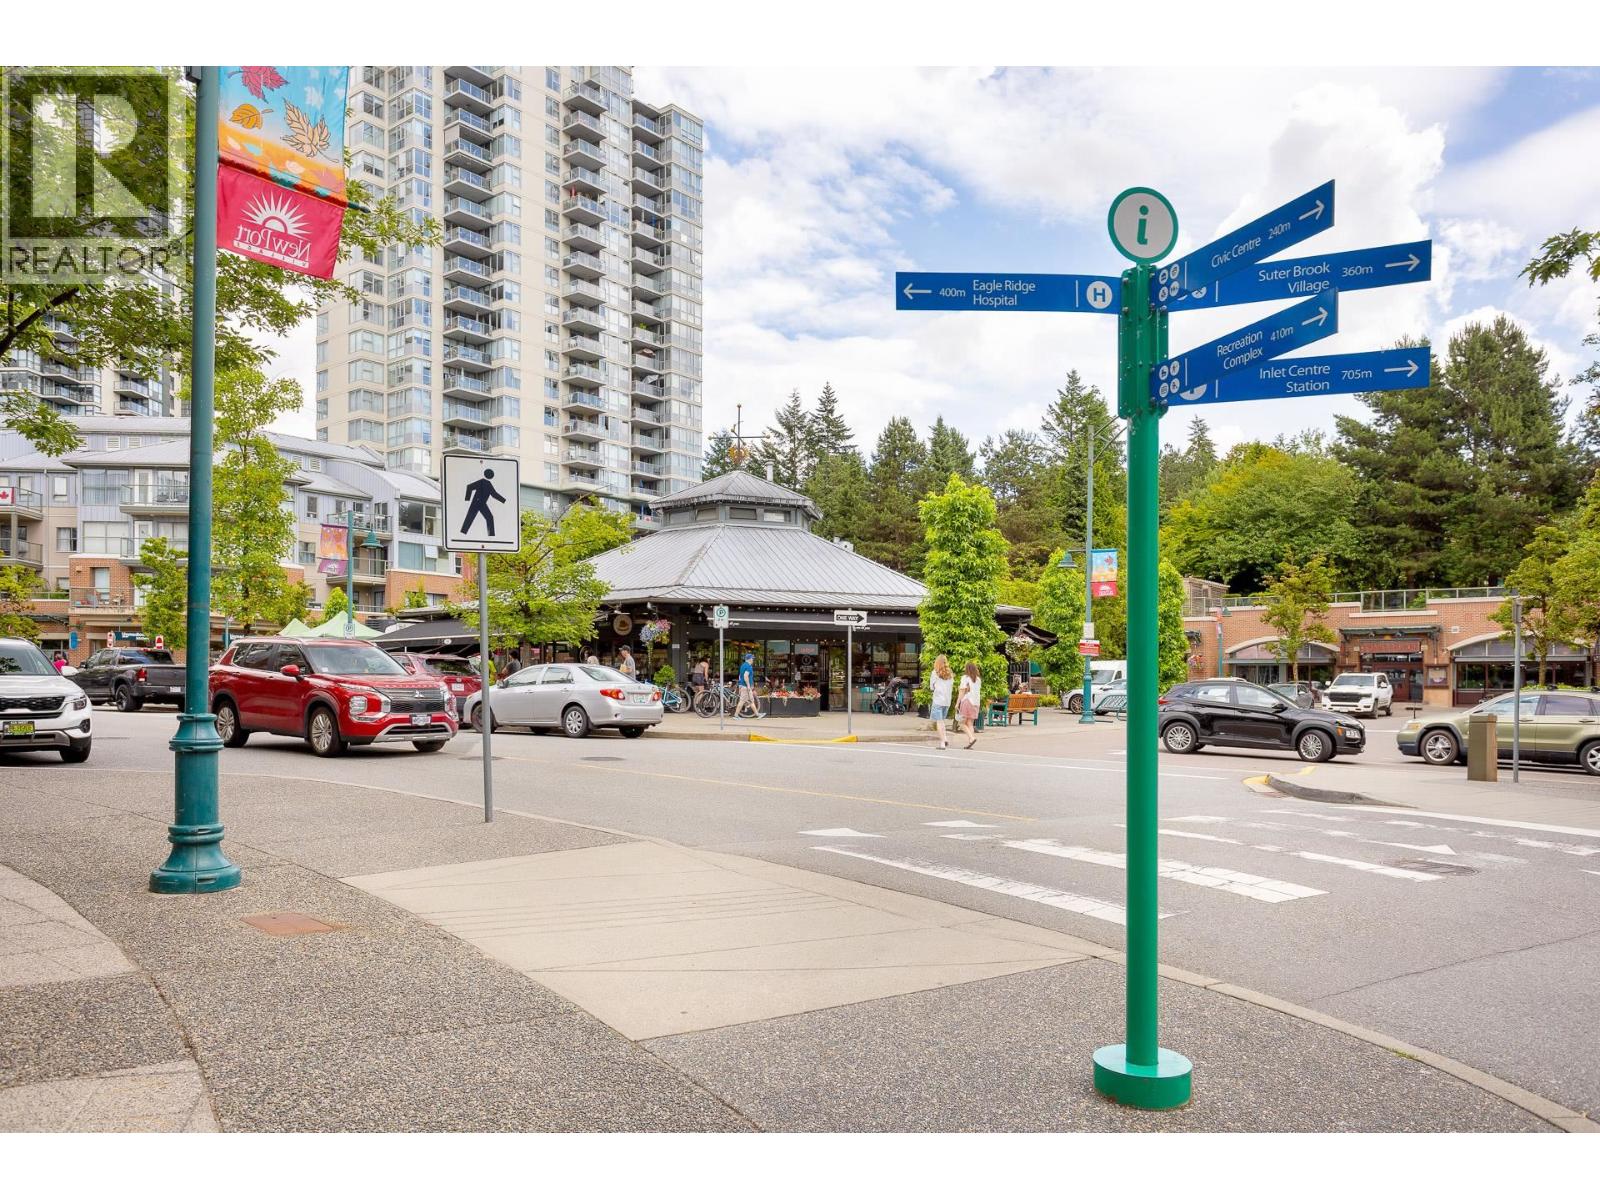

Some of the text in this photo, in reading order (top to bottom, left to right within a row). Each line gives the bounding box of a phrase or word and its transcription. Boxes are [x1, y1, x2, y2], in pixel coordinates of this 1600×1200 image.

[1211, 222, 1291, 268] Civic Centre 240m
[1259, 262, 1374, 281] Suter Brook 360m
[939, 288, 966, 297] 400m
[973, 279, 1036, 294] Eagle Ridge
[1288, 280, 1330, 294] Village
[973, 294, 1018, 308] Hospital
[1217, 326, 1294, 357] Recreation 410m
[1223, 346, 1263, 370] Complex
[1259, 365, 1373, 380] Inlet Centre 705m
[1286, 380, 1330, 393] Station
